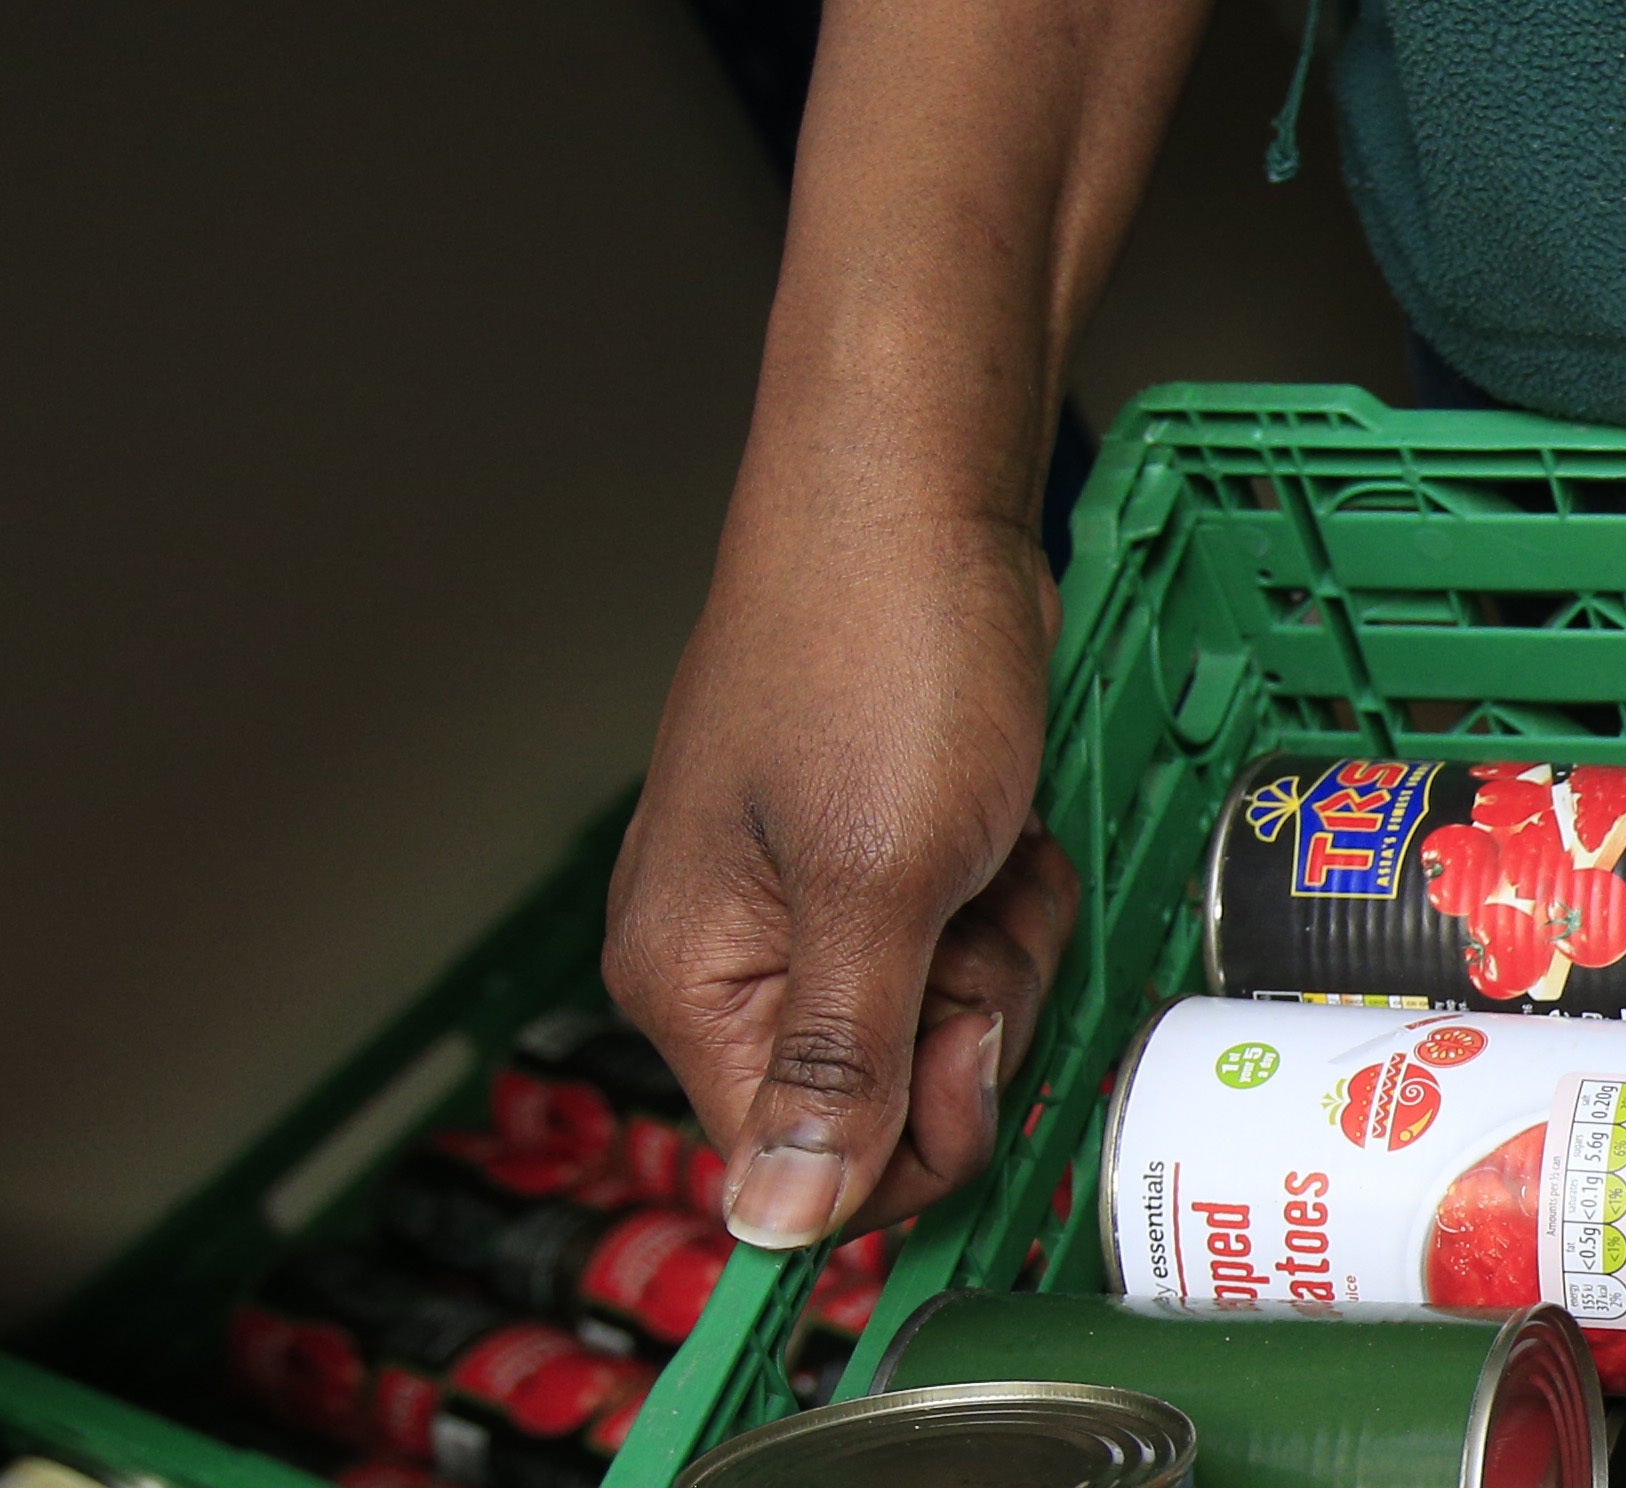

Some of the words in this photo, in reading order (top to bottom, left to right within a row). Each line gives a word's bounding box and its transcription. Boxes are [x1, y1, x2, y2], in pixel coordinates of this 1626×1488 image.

[1304, 760, 1408, 886] TRS
[1591, 1086, 1618, 1118] 0.20g
[1573, 1134, 1585, 1158] sugars
[1586, 1132, 1609, 1162] 5.6g
[1583, 1177, 1604, 1220] <0.1g
[1609, 1189, 1623, 1214] <1%
[1143, 1161, 1169, 1279] essentials
[1275, 1171, 1335, 1302] atoes
[1191, 1202, 1270, 1302] pped
[1580, 1227, 1601, 1271] <0.5g
[1607, 1237, 1621, 1262] <1%
[1570, 1284, 1581, 1308] energy
